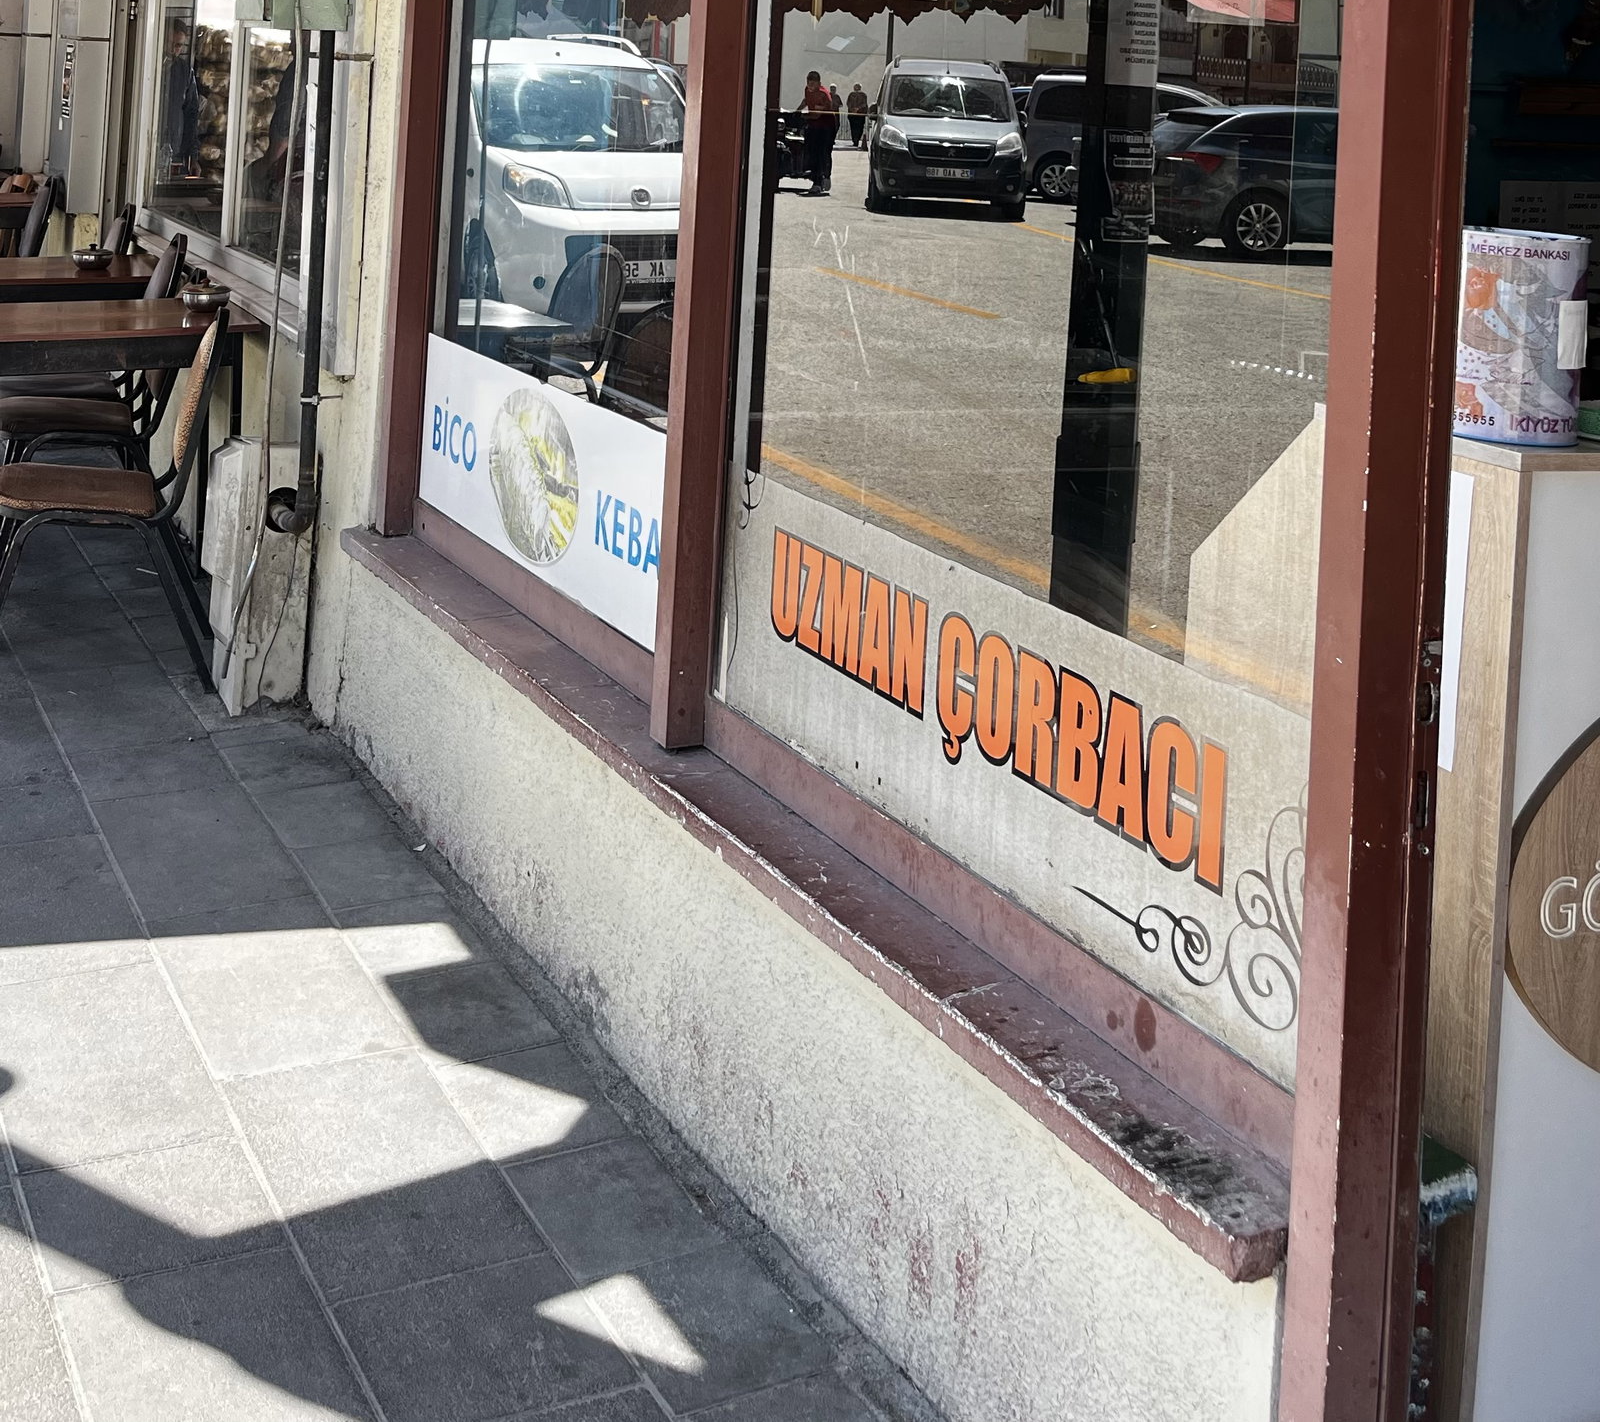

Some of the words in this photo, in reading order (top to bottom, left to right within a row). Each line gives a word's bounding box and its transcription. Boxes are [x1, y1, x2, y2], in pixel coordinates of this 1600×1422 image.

[1470, 242, 1521, 258] MERKEZ
[1524, 248, 1571, 261] BANKASI
[432, 395, 477, 472] BİCO
[770, 525, 929, 721] UZMAN
[936, 610, 1230, 897] ÇORBACI
